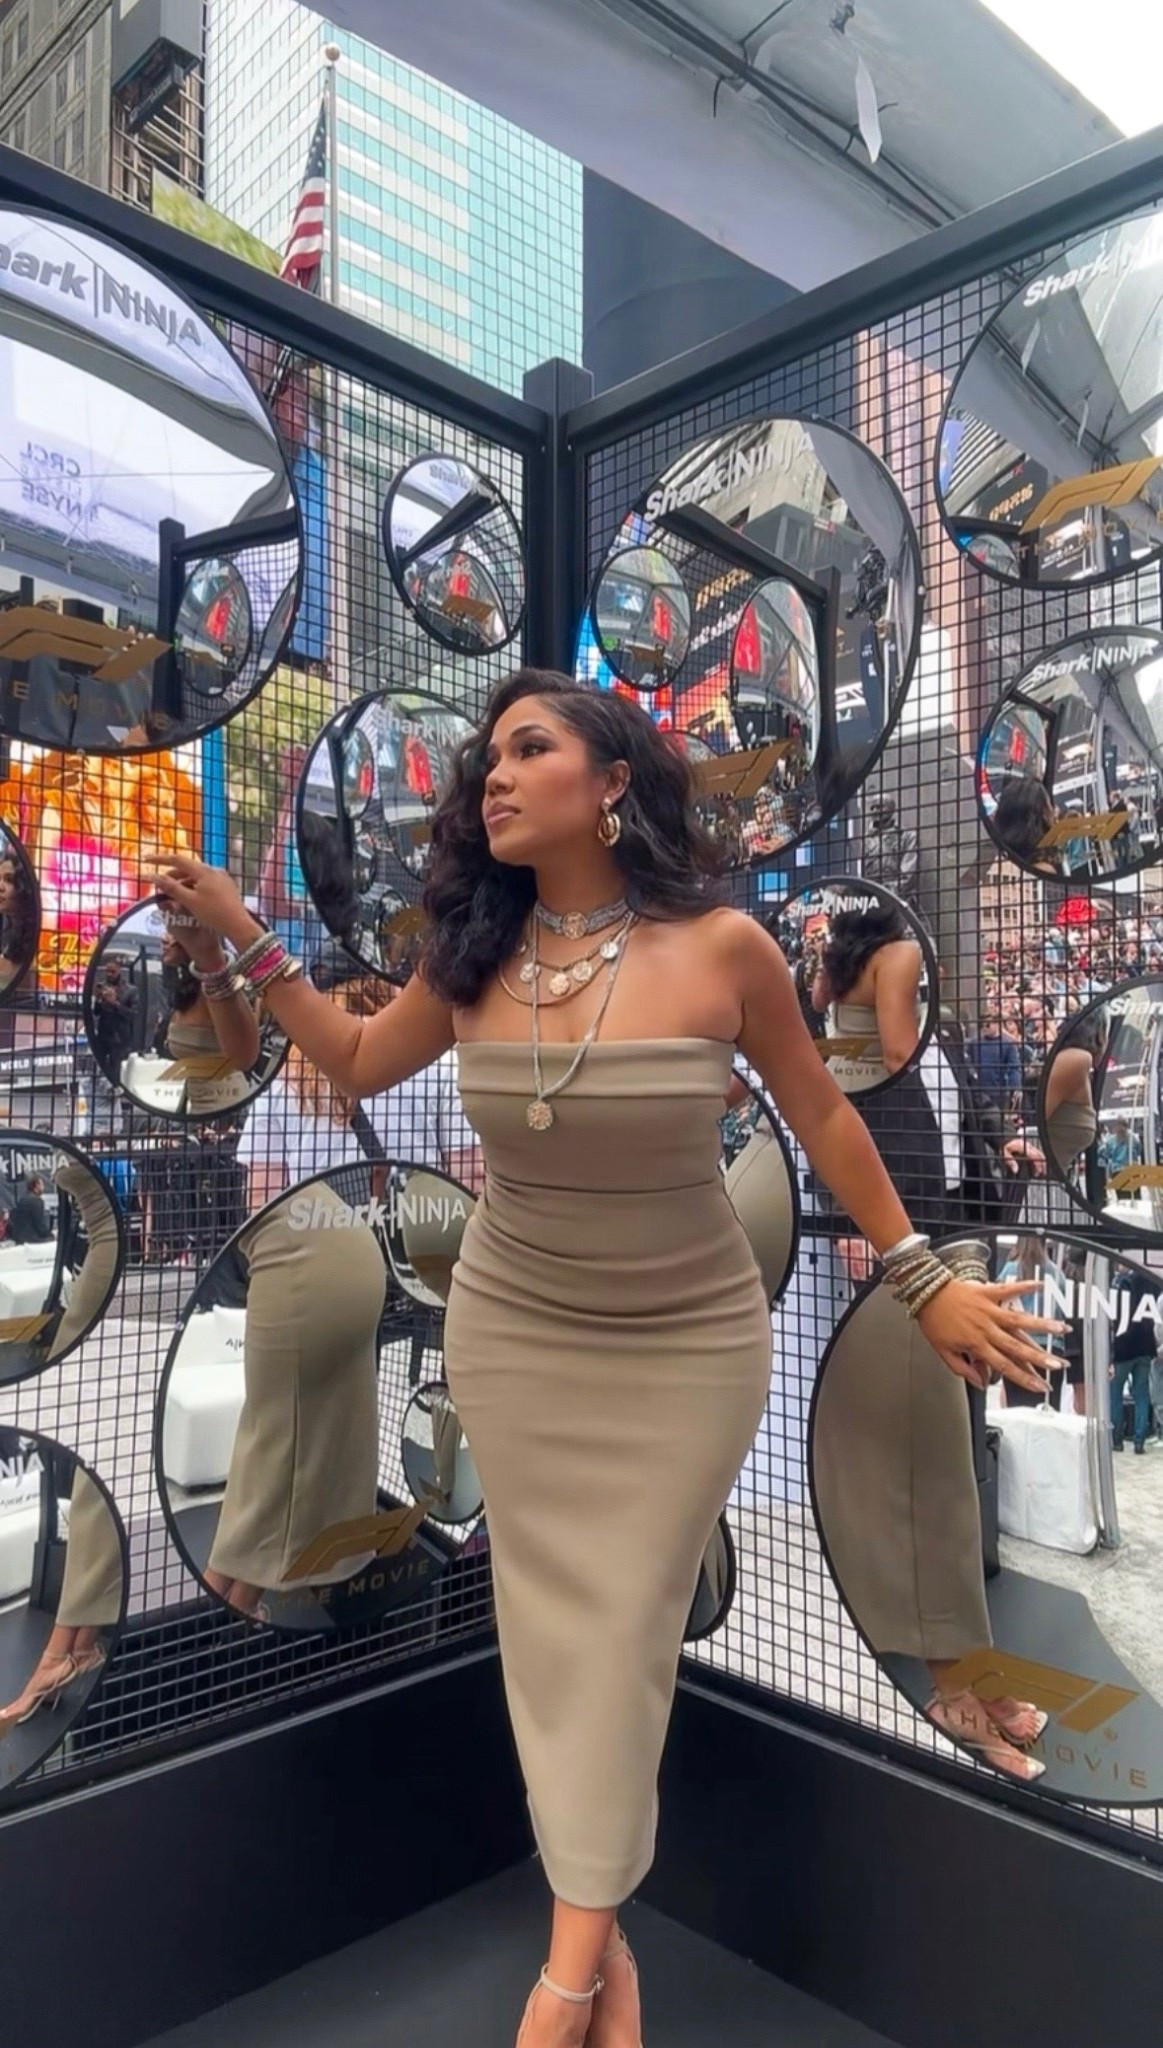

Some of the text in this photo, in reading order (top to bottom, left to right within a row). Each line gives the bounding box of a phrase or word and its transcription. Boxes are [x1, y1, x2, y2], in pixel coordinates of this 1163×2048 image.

[1023, 253, 1109, 307] Shark
[102, 272, 201, 346] NINJA
[644, 432, 815, 522] Shark NINJA
[1032, 644, 1154, 682] Shark NINJA
[372, 705, 435, 741] Shark
[151, 908, 201, 929] Shar
[787, 892, 880, 918] Shark NINJA
[834, 1067, 880, 1077] MOVIE
[17, 1153, 70, 1177] NINJA
[287, 1192, 467, 1233] Shark NINJA
[1044, 1273, 1163, 1337] NINJA
[348, 1559, 431, 1597] MOVIE
[1023, 1738, 1147, 1789] MOVIE
